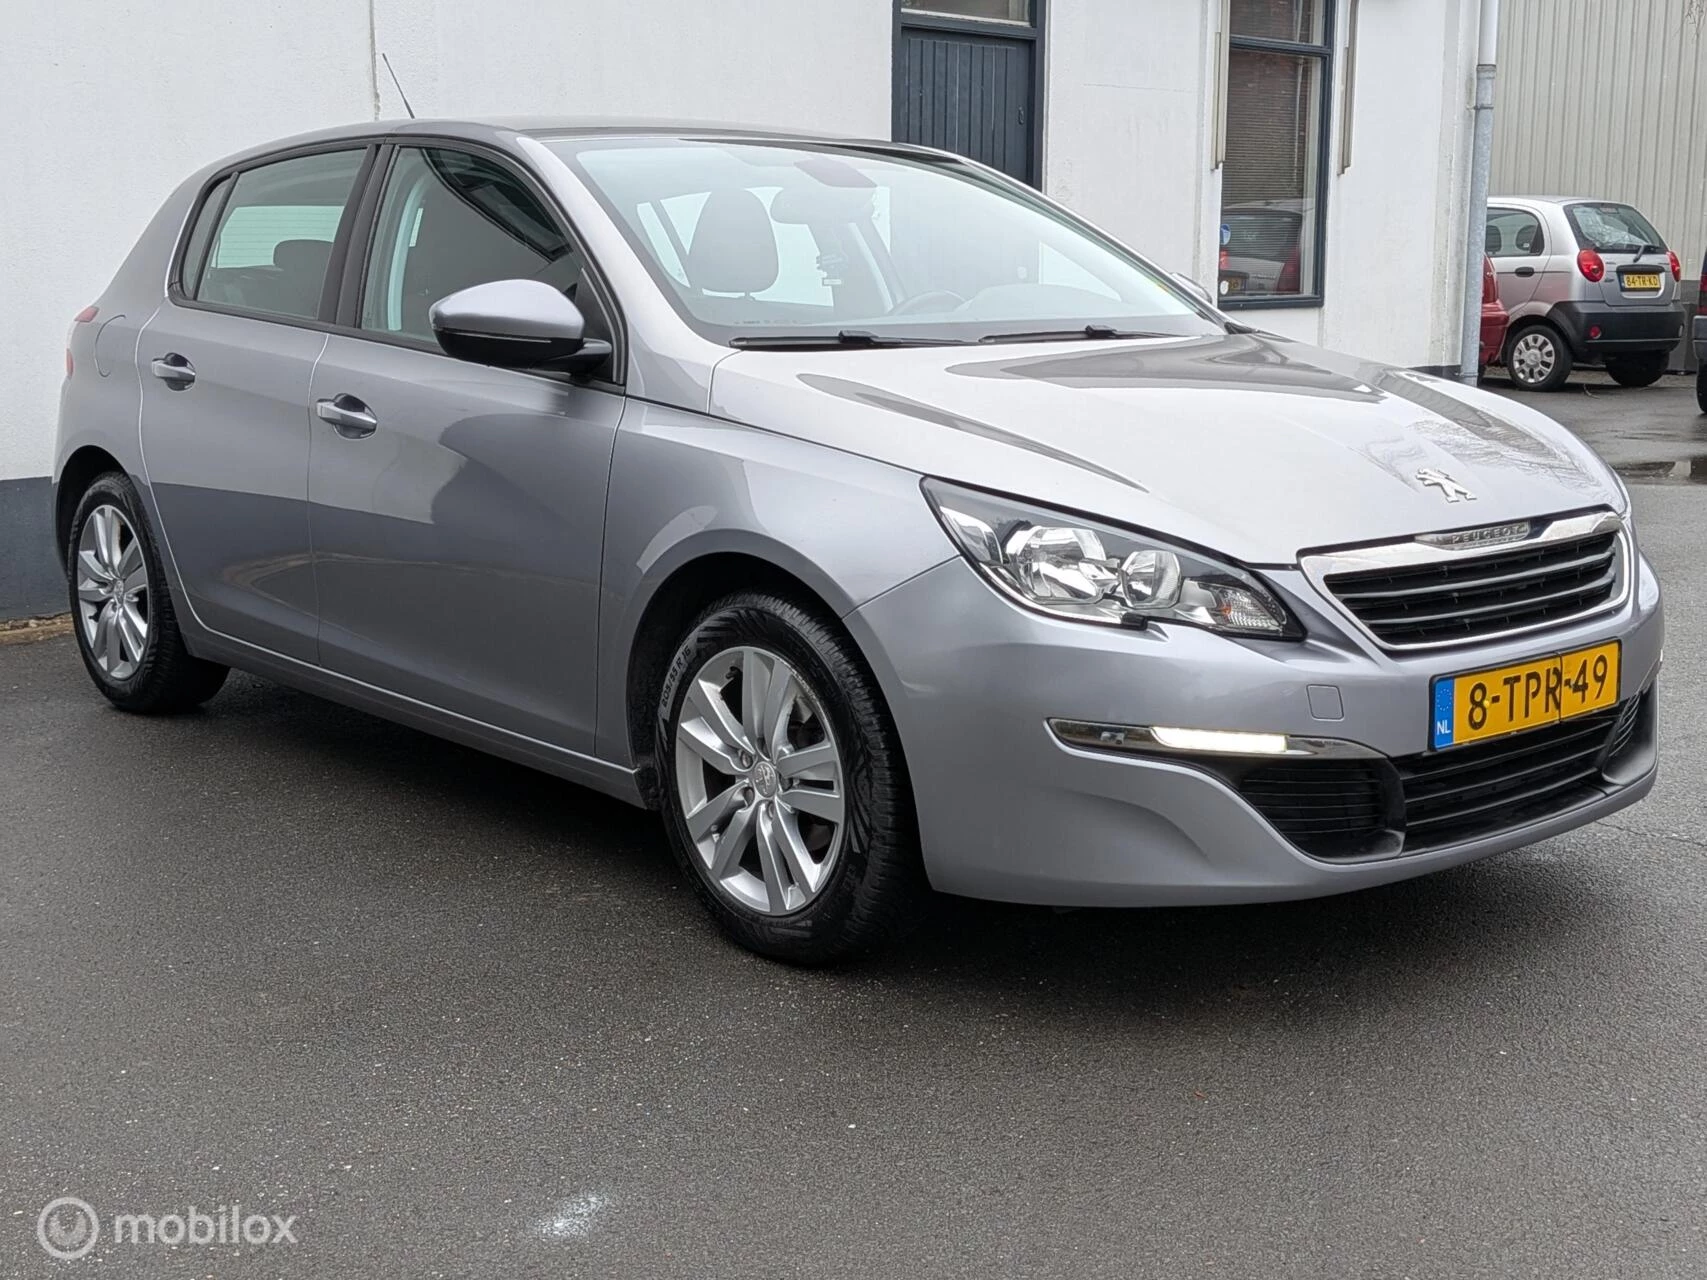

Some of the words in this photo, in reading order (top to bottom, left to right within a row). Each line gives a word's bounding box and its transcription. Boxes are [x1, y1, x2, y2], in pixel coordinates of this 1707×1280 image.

[1452, 526, 1520, 543] PEUGEOT
[1468, 654, 1608, 730] 8-TPR-49
[1436, 721, 1451, 735] NL
